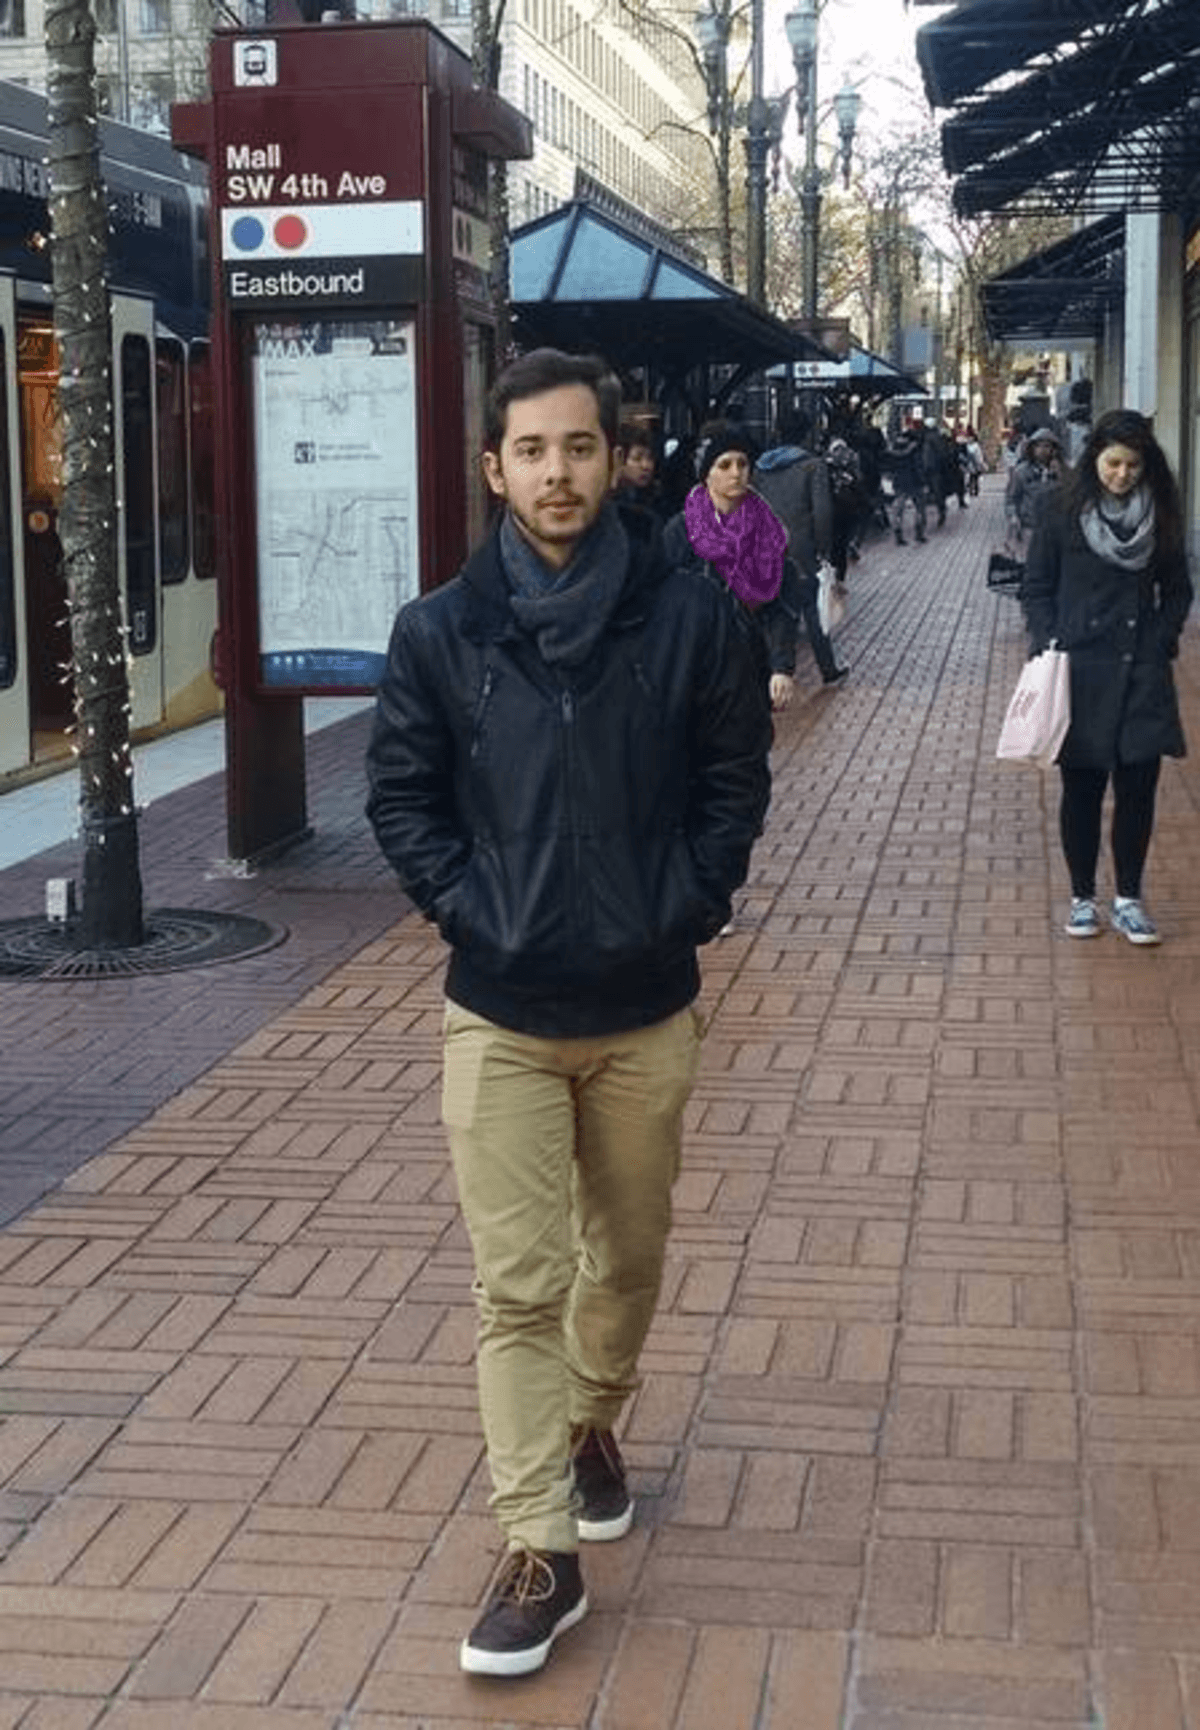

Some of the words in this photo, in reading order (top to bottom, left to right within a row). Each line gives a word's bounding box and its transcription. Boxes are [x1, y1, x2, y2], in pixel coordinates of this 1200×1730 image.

[226, 143, 281, 170] Mall
[227, 174, 275, 200] SW
[280, 173, 328, 199] 4th
[336, 171, 387, 197] Ave
[231, 267, 364, 297] Eastbound
